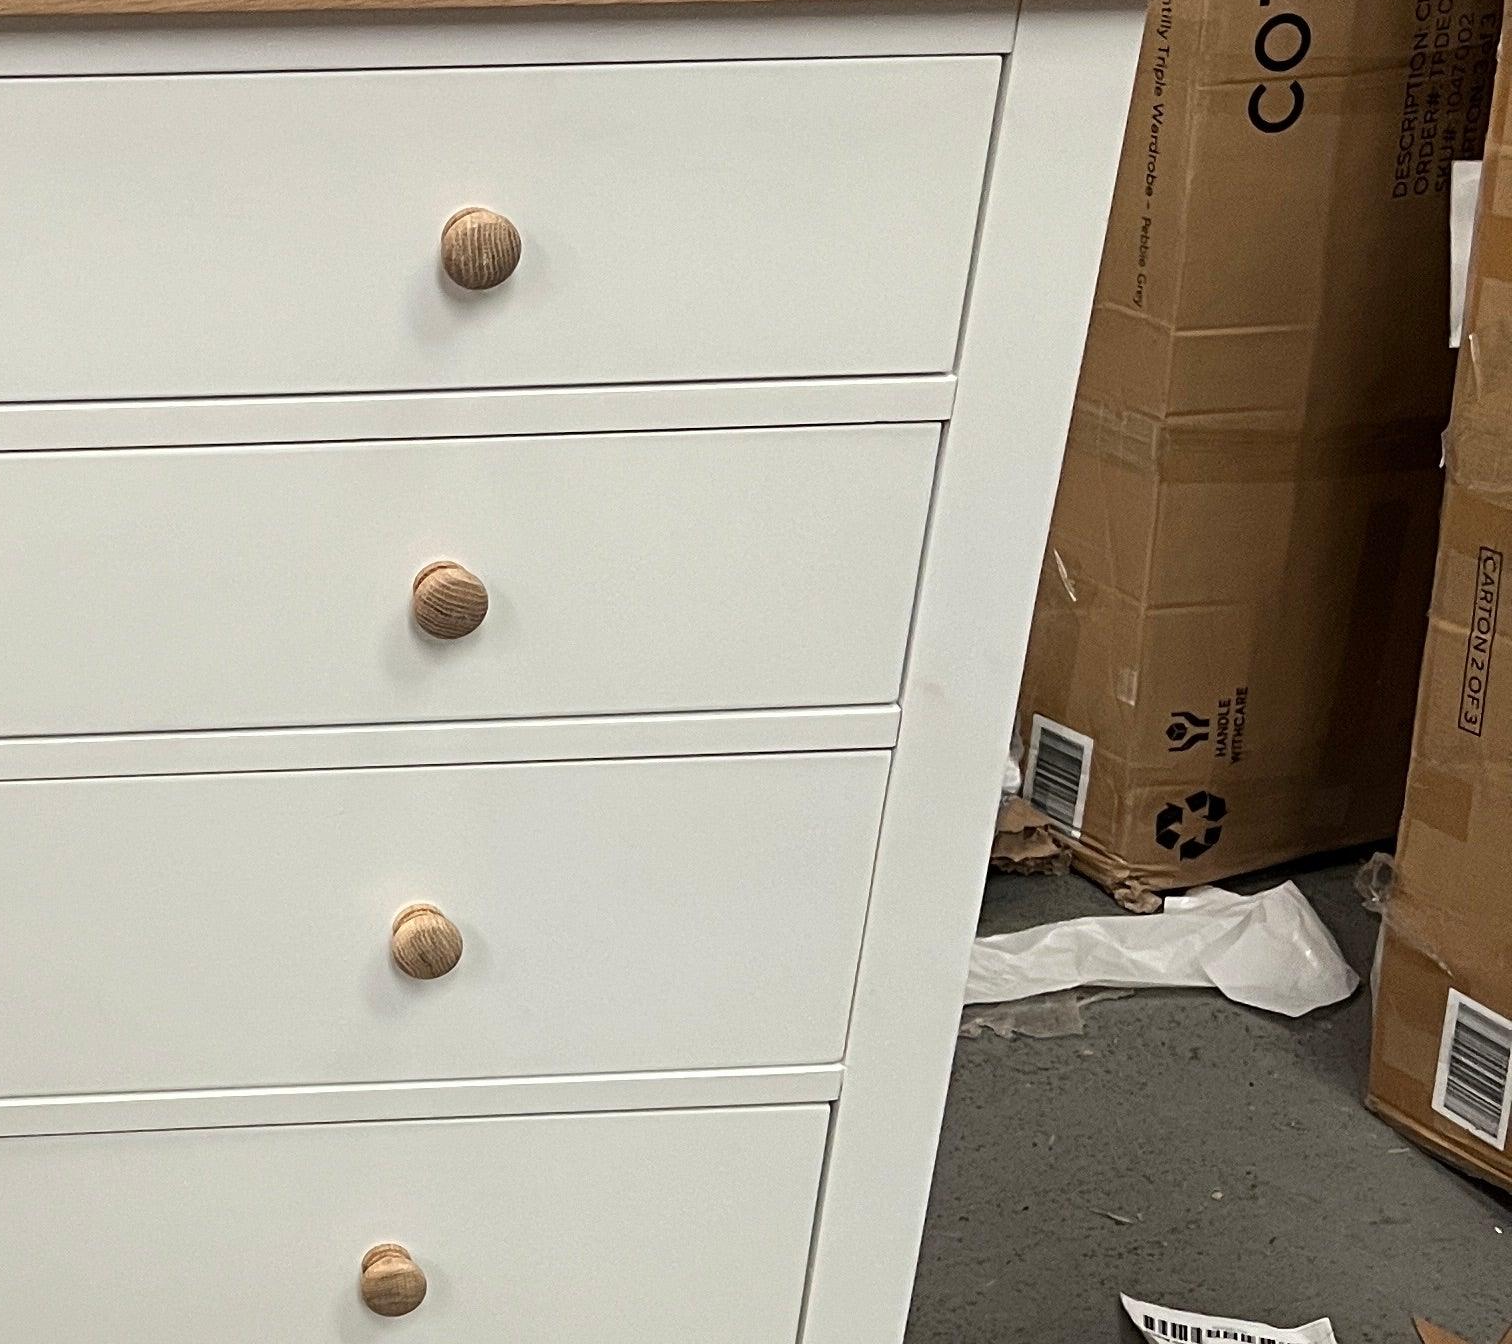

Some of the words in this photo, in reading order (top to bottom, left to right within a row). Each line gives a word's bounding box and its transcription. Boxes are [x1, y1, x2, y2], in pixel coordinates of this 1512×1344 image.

[1153, 46, 1171, 97] Triple
[1144, 103, 1165, 197] Wardrobe
[1138, 216, 1152, 268] Pebble
[1132, 273, 1147, 308] Grey
[1473, 556, 1497, 654] CARTON
[1470, 657, 1485, 672] 2
[1464, 710, 1478, 725] 3
[1467, 675, 1482, 710] OF
[1216, 698, 1232, 758] HANDLE
